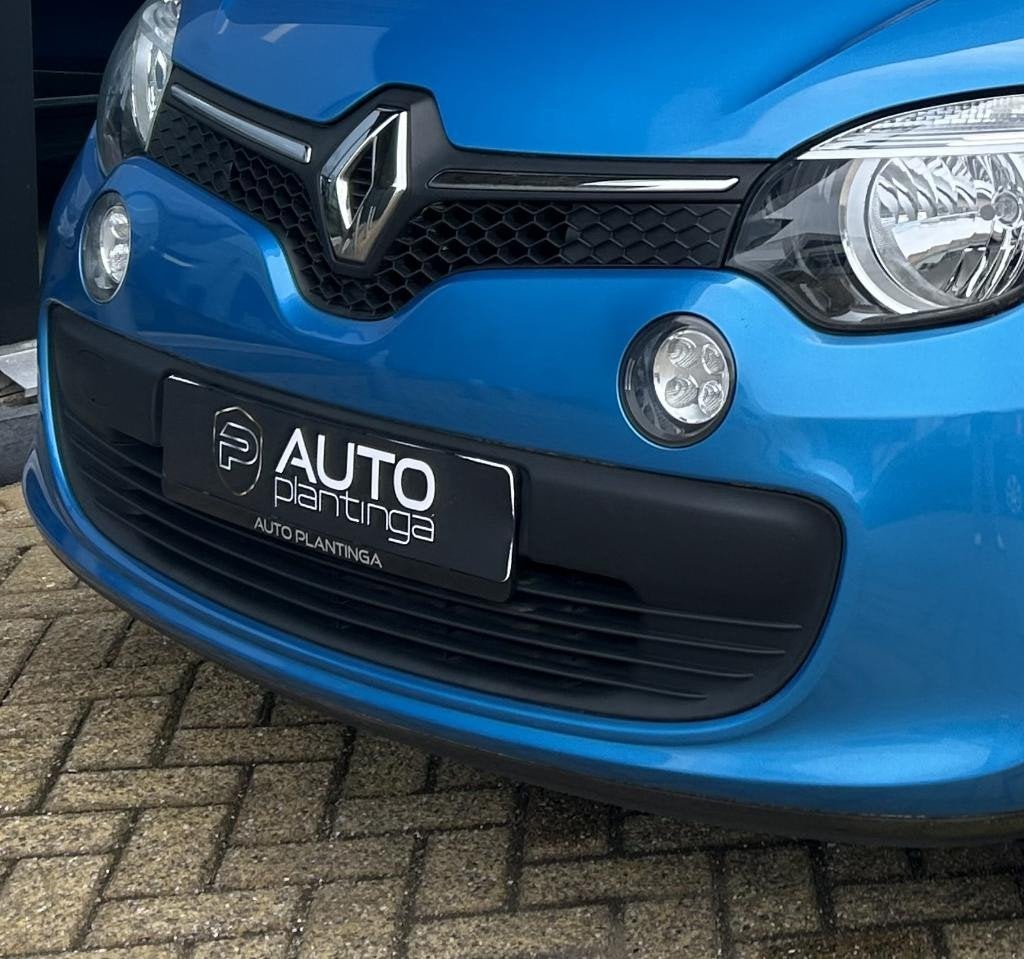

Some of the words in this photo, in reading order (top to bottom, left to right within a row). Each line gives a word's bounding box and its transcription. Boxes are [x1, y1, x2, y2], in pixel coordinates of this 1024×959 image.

[275, 428, 436, 512] AUTO
[253, 516, 293, 540] AUTO
[295, 528, 383, 568] PLANTINGA
[274, 474, 436, 545] plantinga
